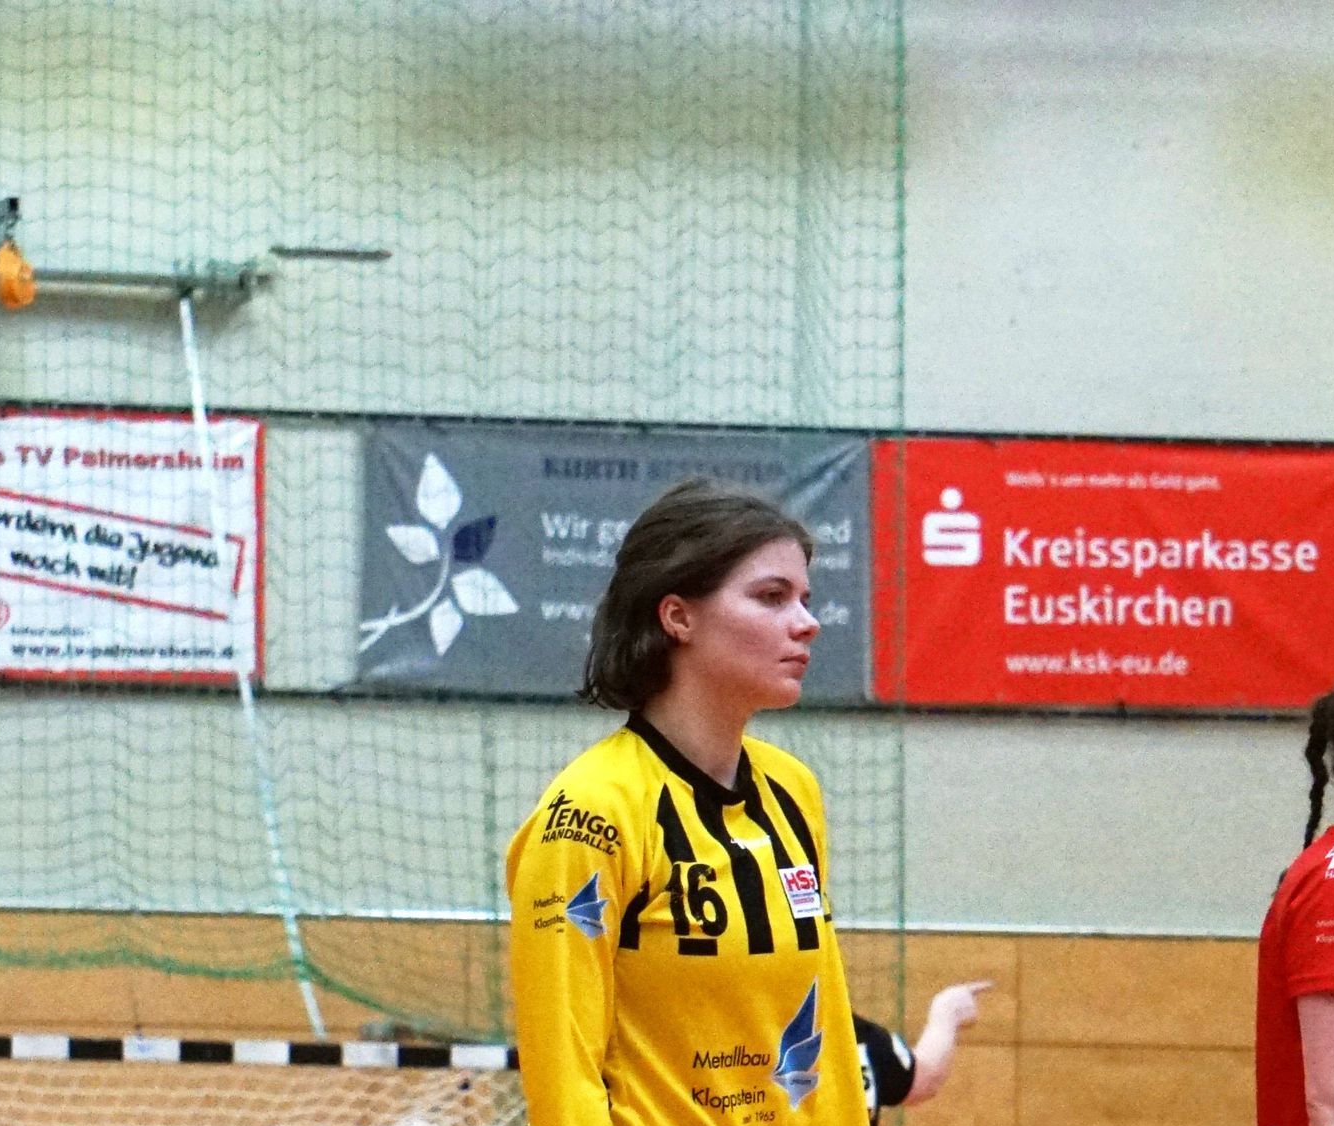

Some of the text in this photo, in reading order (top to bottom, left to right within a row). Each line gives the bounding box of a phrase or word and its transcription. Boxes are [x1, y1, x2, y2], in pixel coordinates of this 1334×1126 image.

[16, 445, 53, 467] TV
[84, 522, 124, 551] die
[541, 512, 590, 540] Wir
[1002, 528, 1318, 577] Kreissparkasse
[10, 550, 138, 590] mach mit!
[1003, 584, 1233, 627] Euskirchen
[1005, 651, 1189, 675] www.ksk-eu.de
[546, 789, 621, 843] TENGO
[664, 863, 729, 938] 16
[692, 1045, 771, 1069] Metallbau
[691, 1086, 766, 1115] Kloppstein
[754, 1111, 776, 1123] 1965
